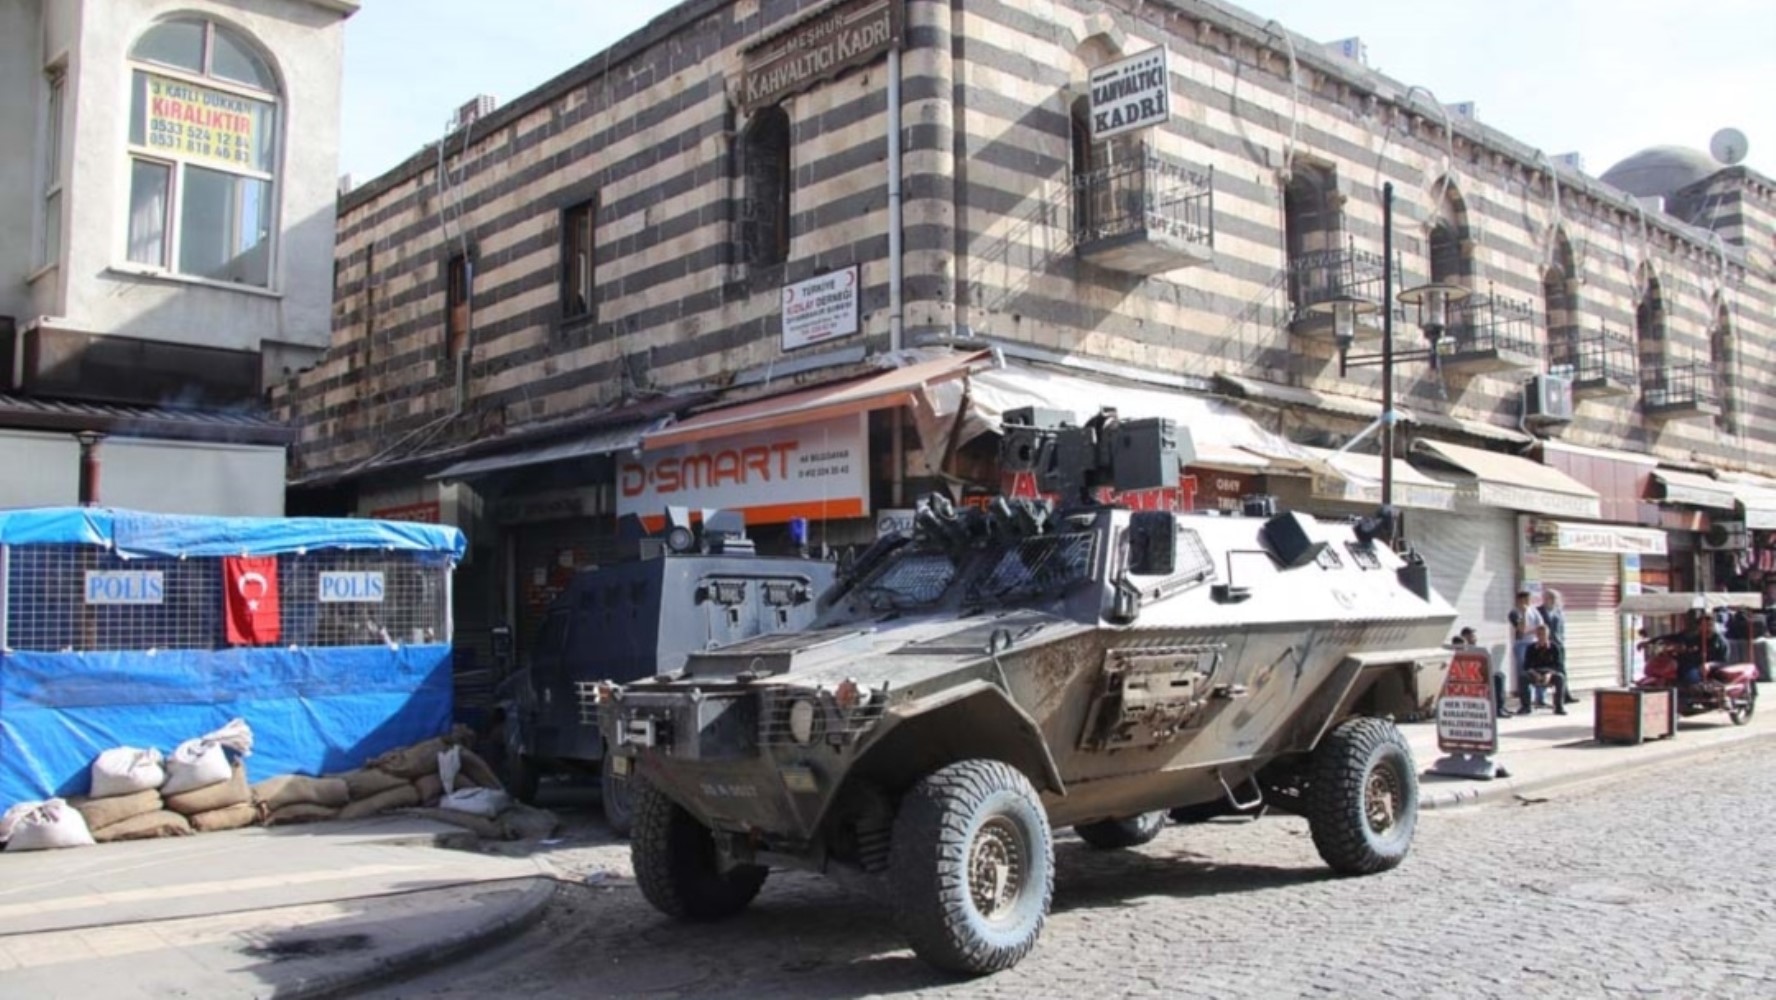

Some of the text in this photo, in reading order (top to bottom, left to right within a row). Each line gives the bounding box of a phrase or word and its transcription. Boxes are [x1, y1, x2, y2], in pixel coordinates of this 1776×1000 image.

[786, 13, 845, 52] MEŞHUR
[747, 10, 891, 102] KAHVALTICI KADRİ
[1093, 65, 1163, 107] KAHVALTICI
[1094, 89, 1164, 134] KADRİ
[151, 118, 183, 136] 0533
[802, 279, 835, 297] TÜRKİYE
[816, 288, 853, 308] DERNEĞİ
[88, 573, 163, 600] POLİS
[321, 573, 382, 600] POLİS
[1448, 660, 1484, 682] AK
